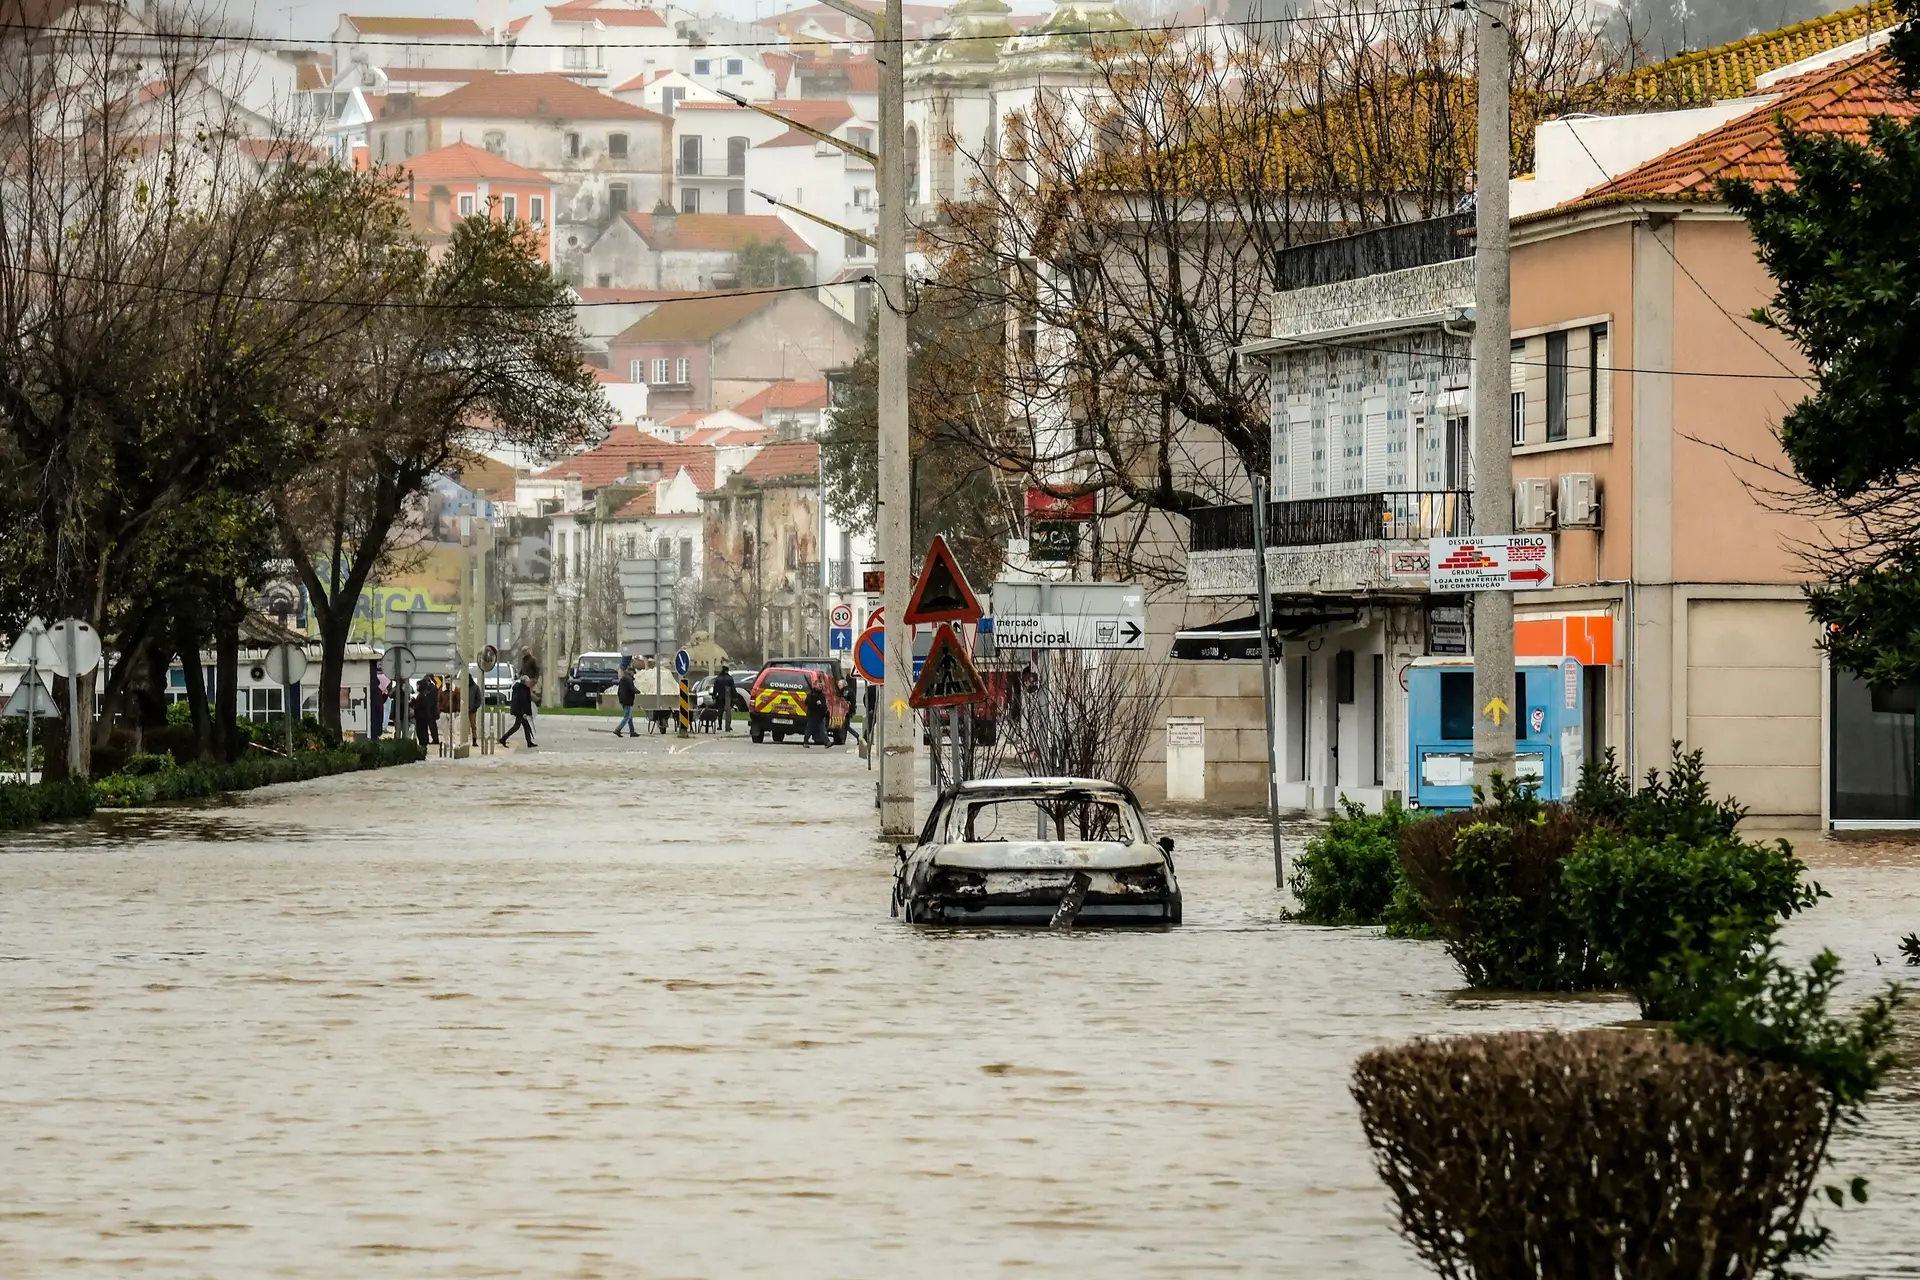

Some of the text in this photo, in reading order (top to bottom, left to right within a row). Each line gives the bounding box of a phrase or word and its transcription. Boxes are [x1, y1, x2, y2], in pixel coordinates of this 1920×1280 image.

[1508, 537, 1544, 546] TRIPLO
[835, 612, 849, 621] 30
[996, 618, 1039, 627] mercado
[996, 631, 1070, 646] municipal
[769, 682, 803, 690] COMANDO
